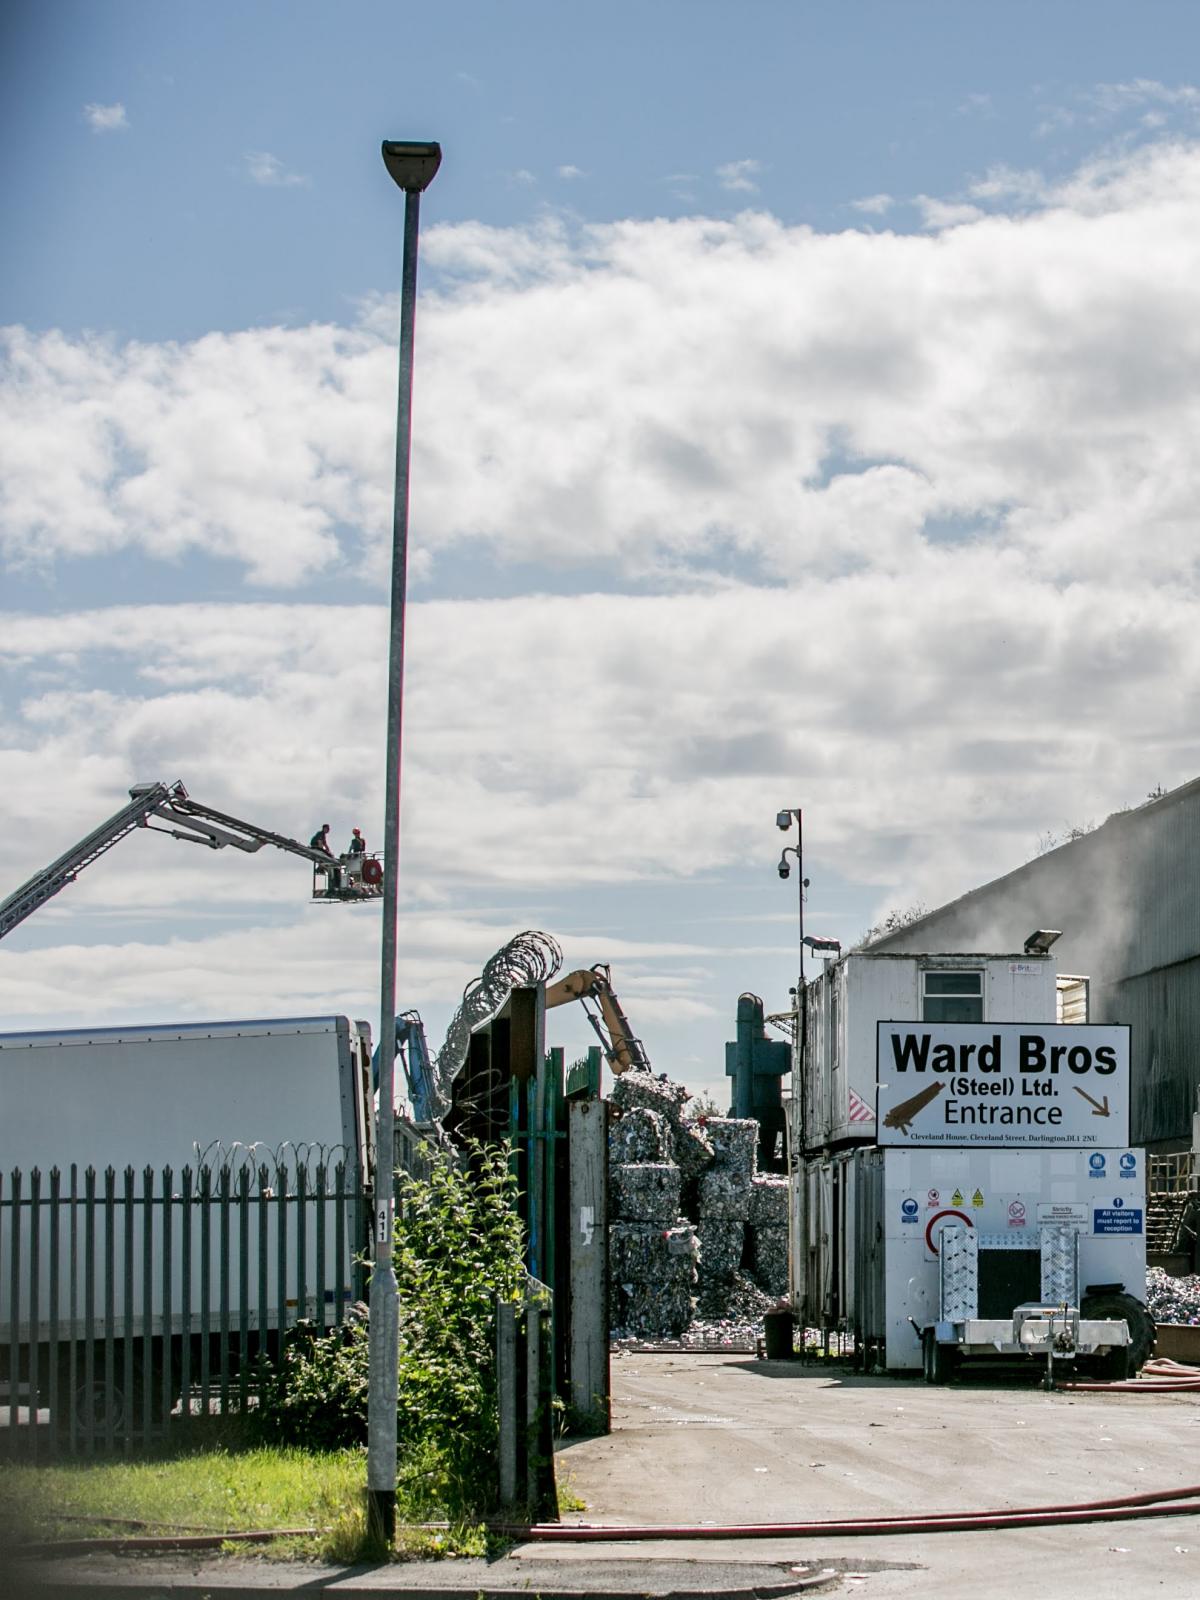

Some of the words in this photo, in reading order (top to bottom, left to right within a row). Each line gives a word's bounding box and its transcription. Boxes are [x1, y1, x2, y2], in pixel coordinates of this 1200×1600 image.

[891, 1034, 1002, 1073] Ward
[1019, 1035, 1117, 1075] Bros
[950, 1077, 1015, 1097] (Steel)
[1021, 1078, 1059, 1097] Ltd.
[944, 1099, 1063, 1125] Entrance
[910, 1133, 945, 1141] Cleveland
[970, 1133, 1004, 1141] Cleveland
